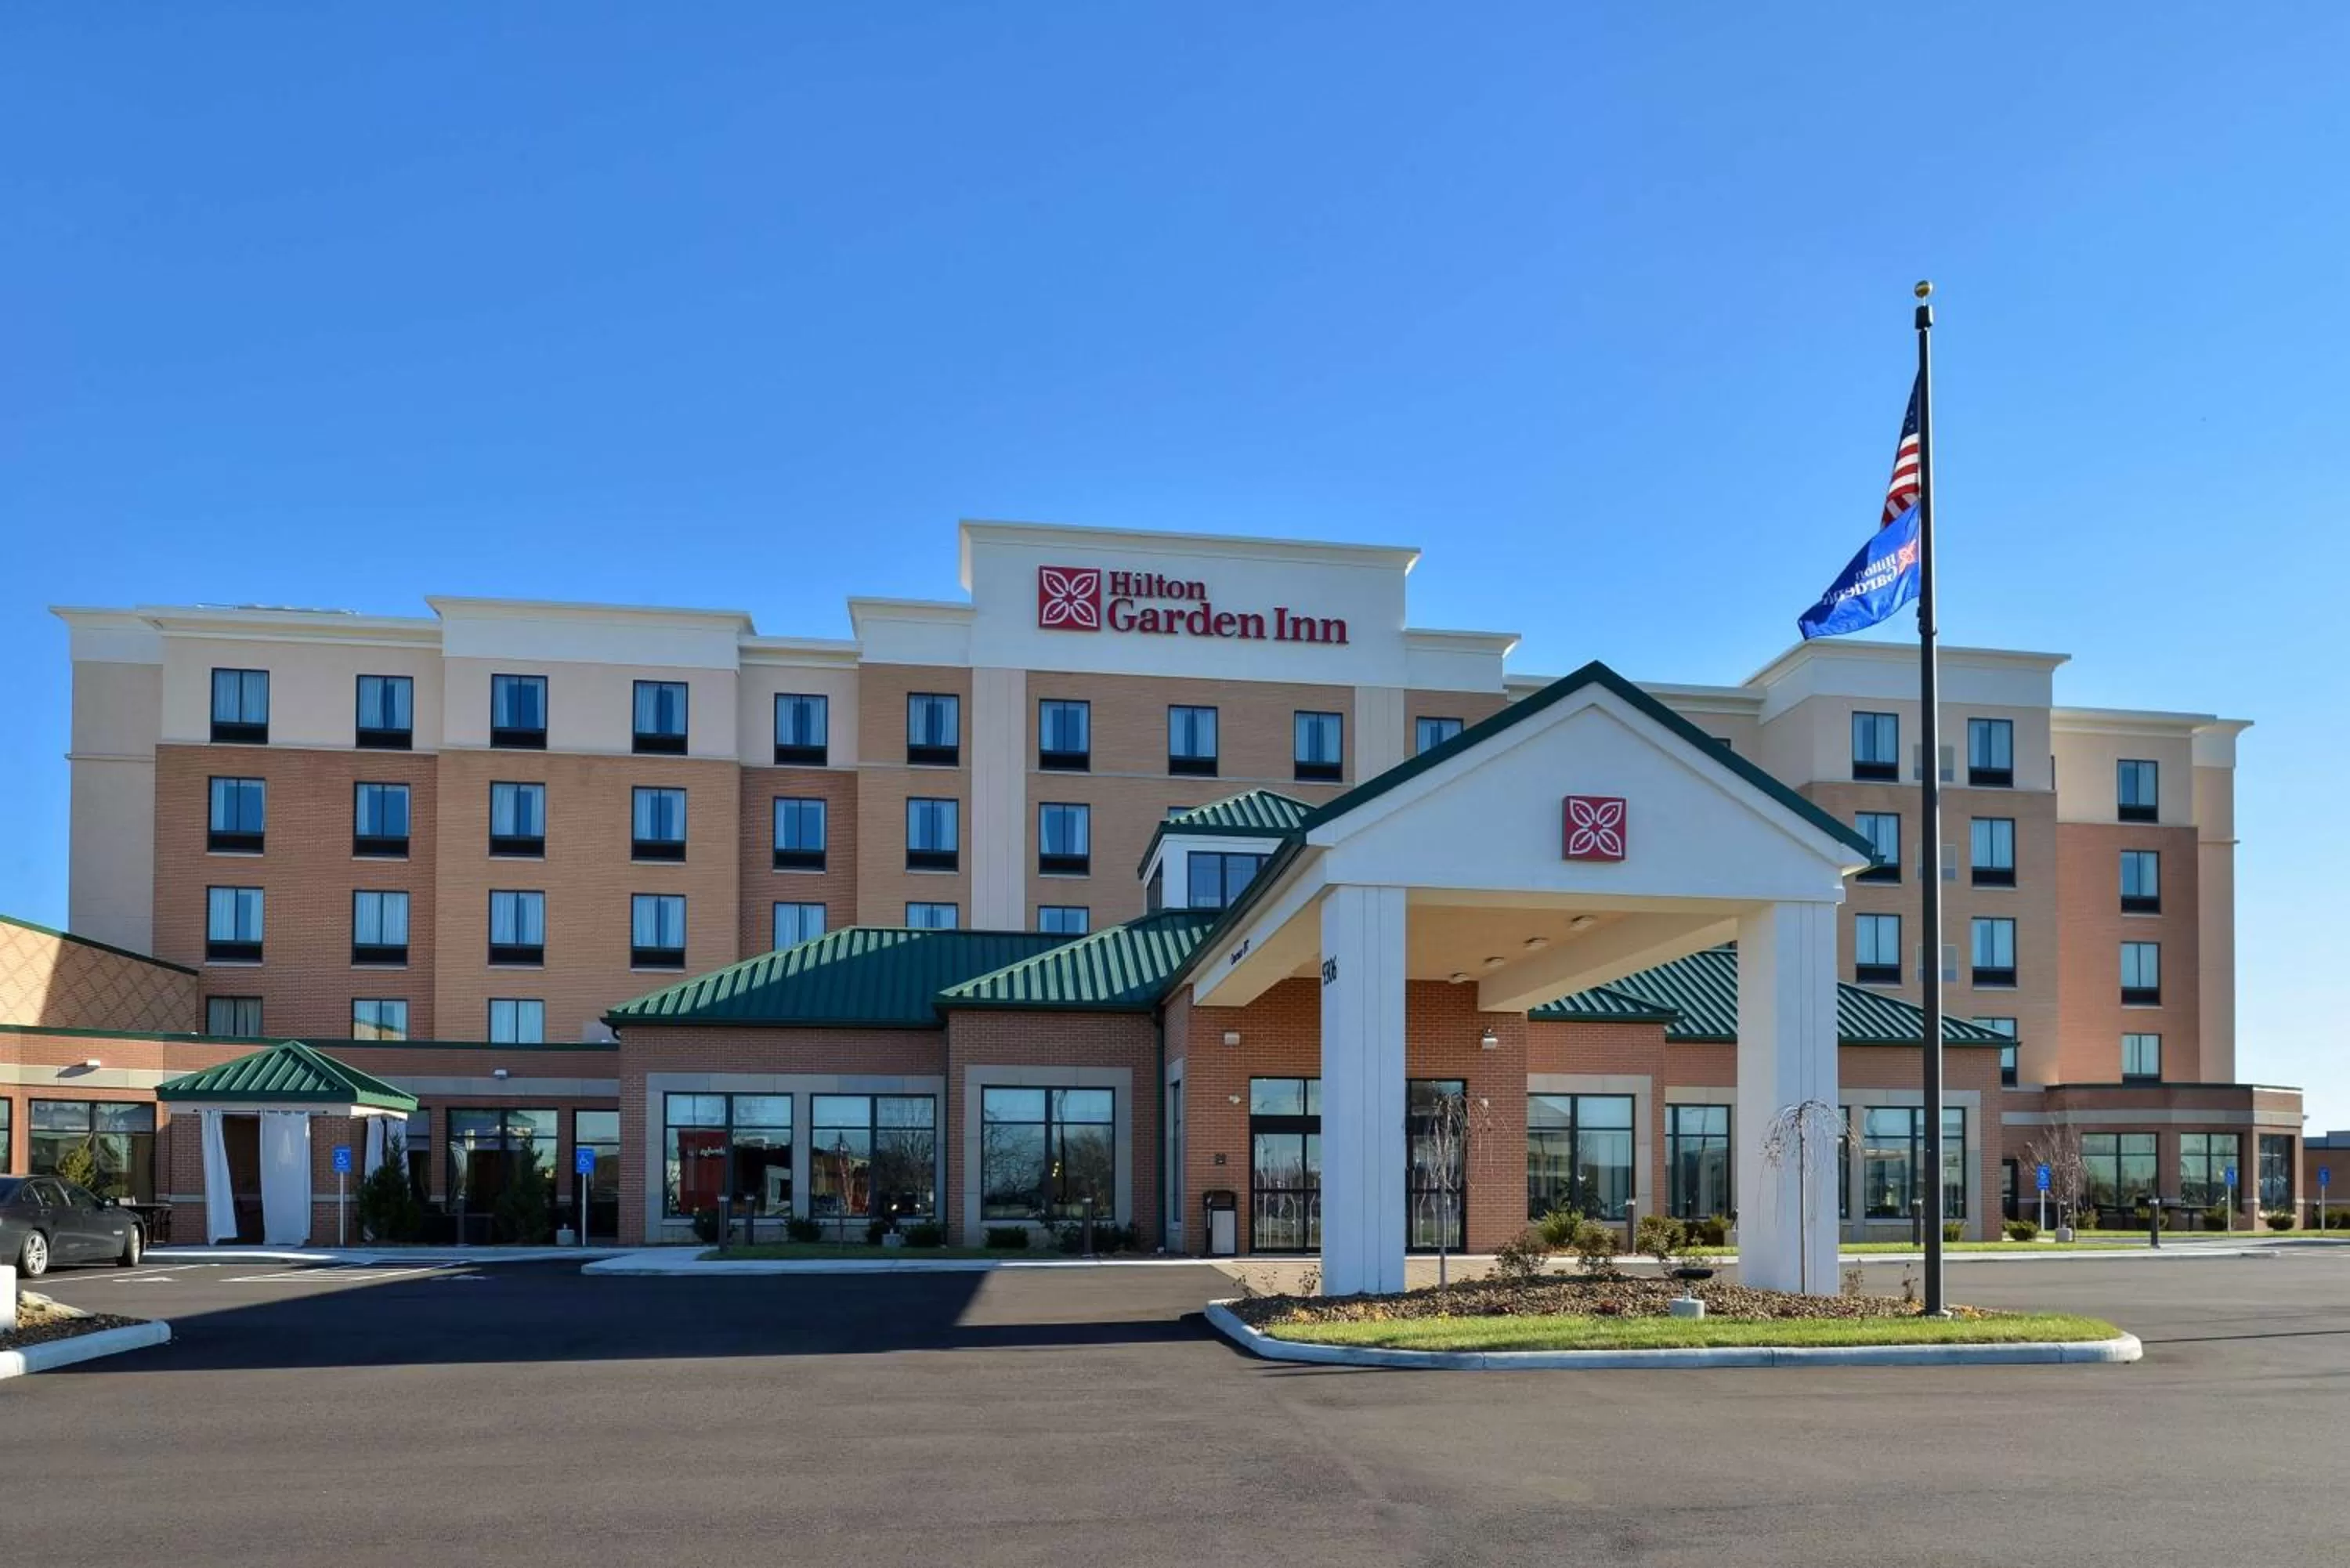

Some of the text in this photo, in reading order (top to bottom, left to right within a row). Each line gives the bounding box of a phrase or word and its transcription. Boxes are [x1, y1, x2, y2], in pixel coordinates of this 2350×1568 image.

[1108, 570, 1207, 601] Hilton
[1107, 598, 1349, 645] Garden Inn
